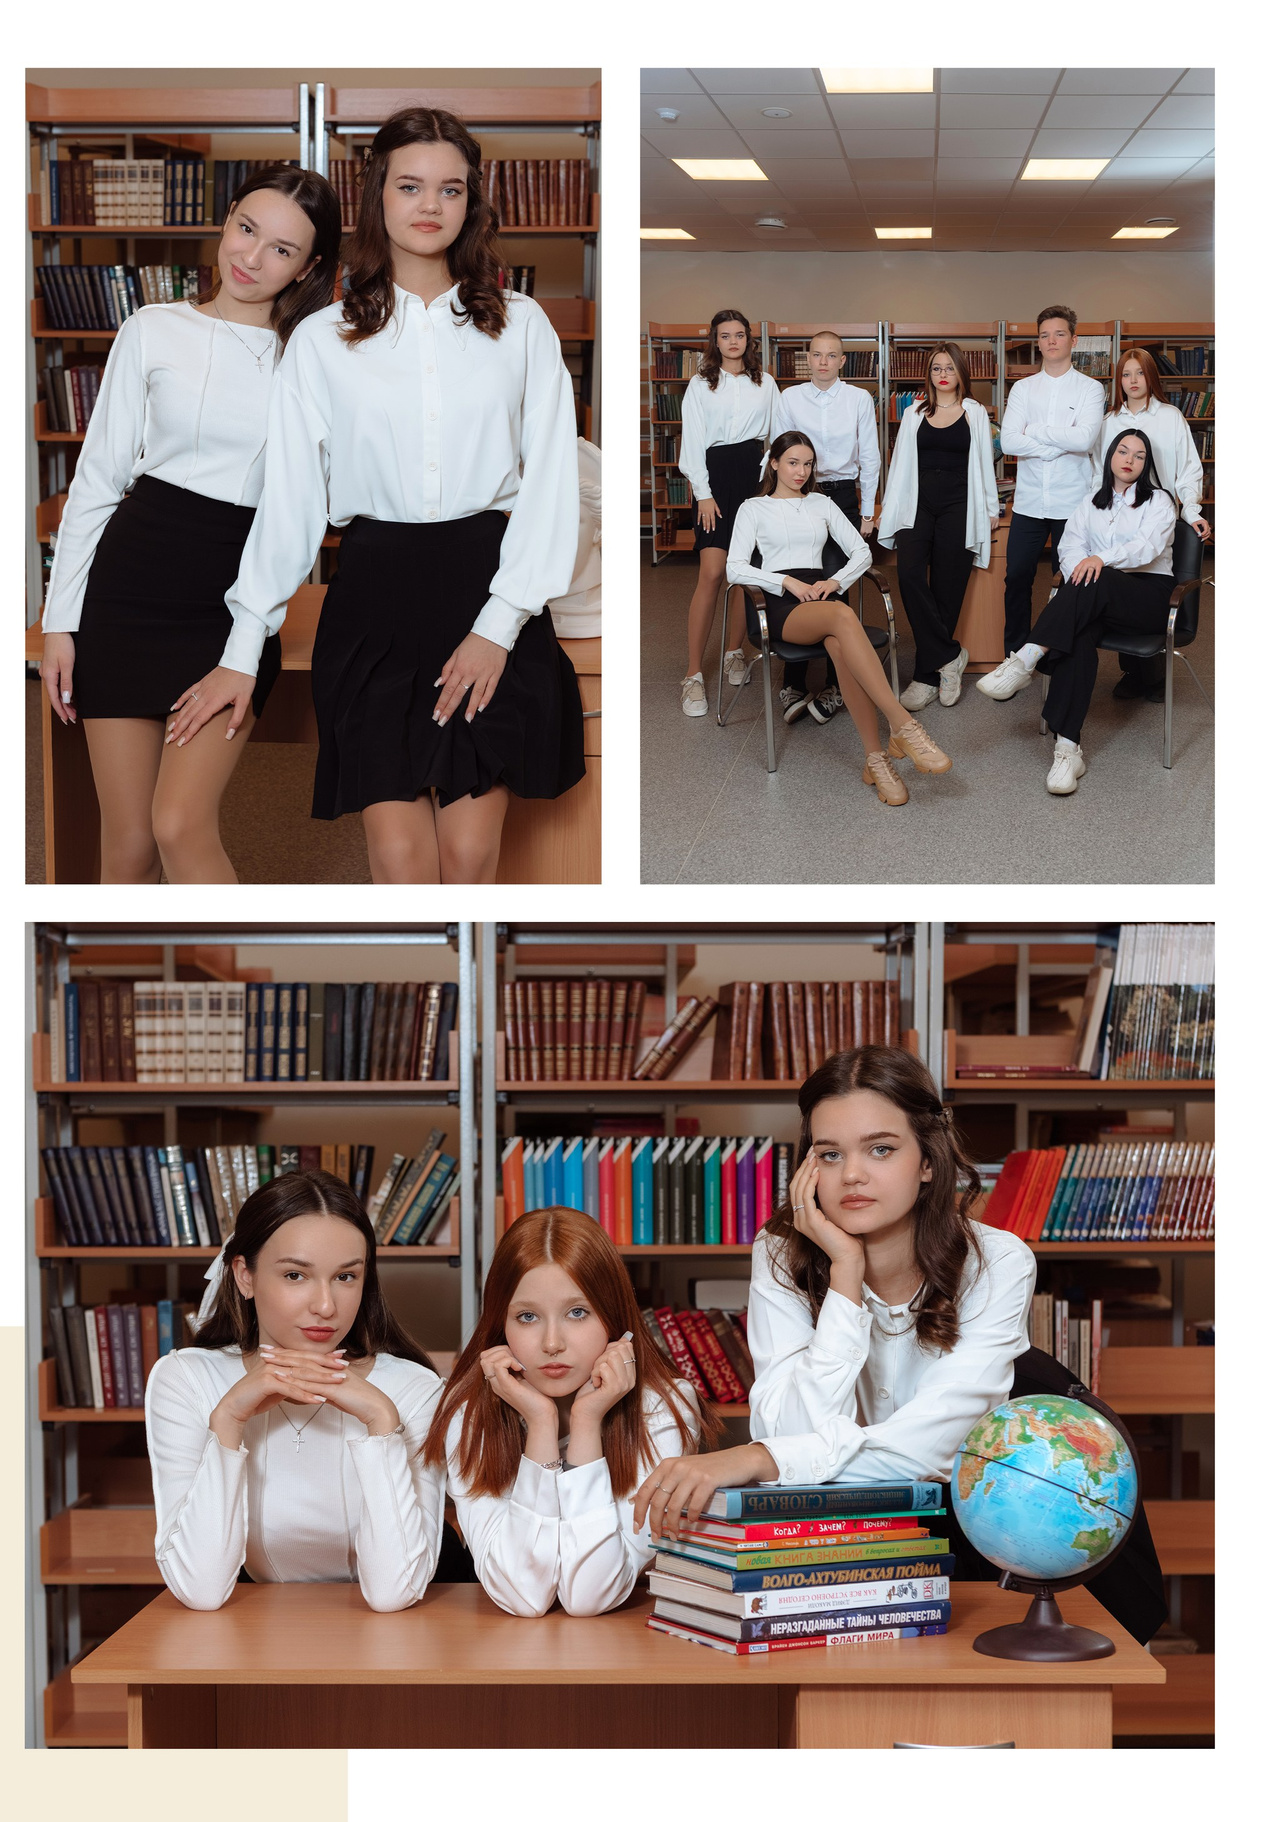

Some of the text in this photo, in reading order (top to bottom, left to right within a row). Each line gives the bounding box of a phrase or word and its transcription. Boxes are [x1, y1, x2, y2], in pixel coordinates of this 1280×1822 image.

[748, 1493, 823, 1512] СЛОВАРЬ
[774, 1552, 814, 1565] КНИГА
[870, 1547, 895, 1556] вопросах
[762, 1561, 941, 1589] ВОЛГО-АХТУБИНСКАЯ ПОЙМА
[811, 1592, 848, 1601] УСТРОЕНО
[865, 1588, 877, 1596] КАК
[924, 1582, 933, 1599] DK
[778, 1595, 811, 1604] СЕГОДНЯ
[770, 1609, 942, 1635] НЕРАЗГАДАННЫЕ ТАЙНЫ ЧЕЛОВЕЧЕСТВА
[830, 1631, 894, 1645] ФЛАГИ МИРА
